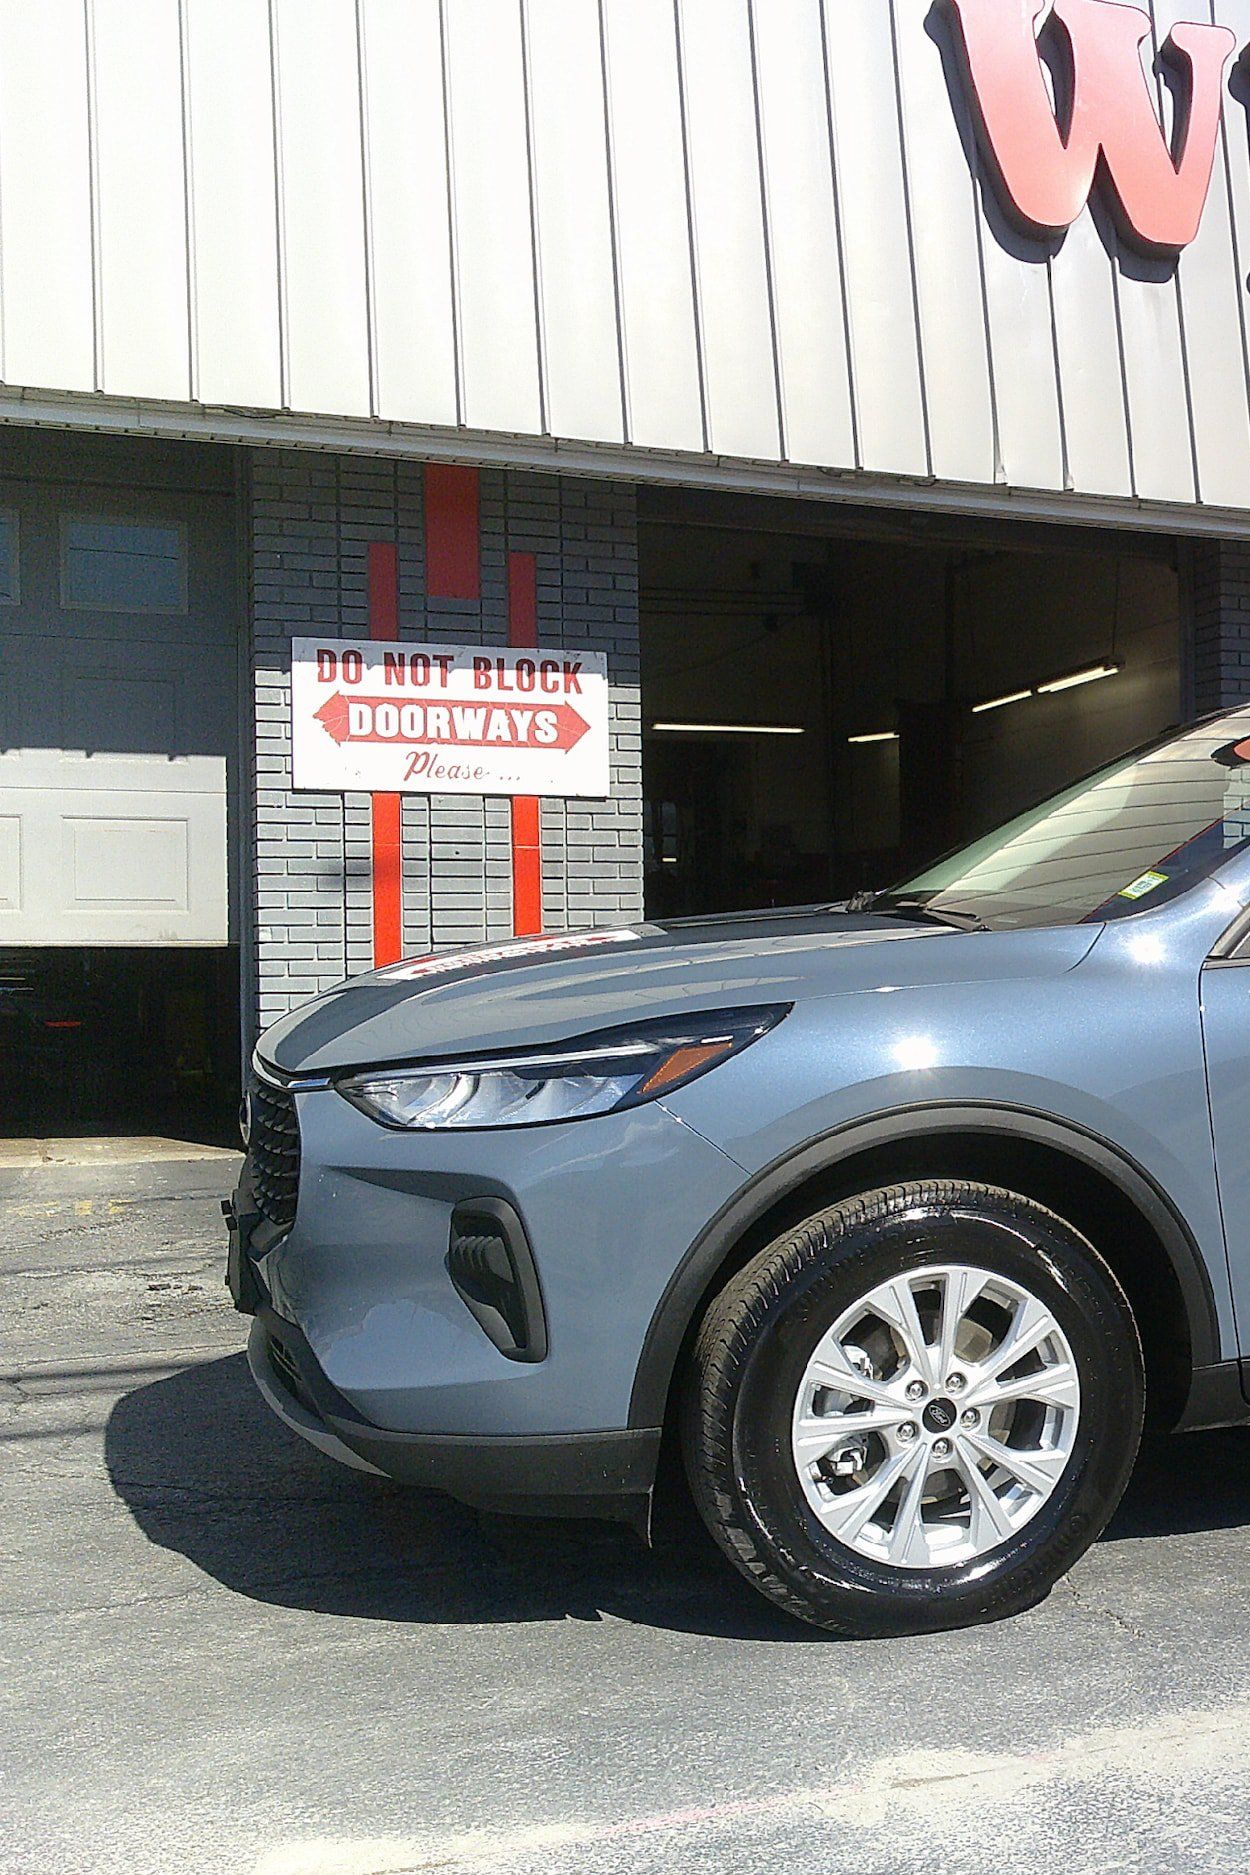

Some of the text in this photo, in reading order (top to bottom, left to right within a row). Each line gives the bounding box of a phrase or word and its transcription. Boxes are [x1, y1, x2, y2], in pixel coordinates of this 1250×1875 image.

[316, 649, 583, 694] DO NOT BLOCK
[349, 702, 558, 744] DOORWAYS
